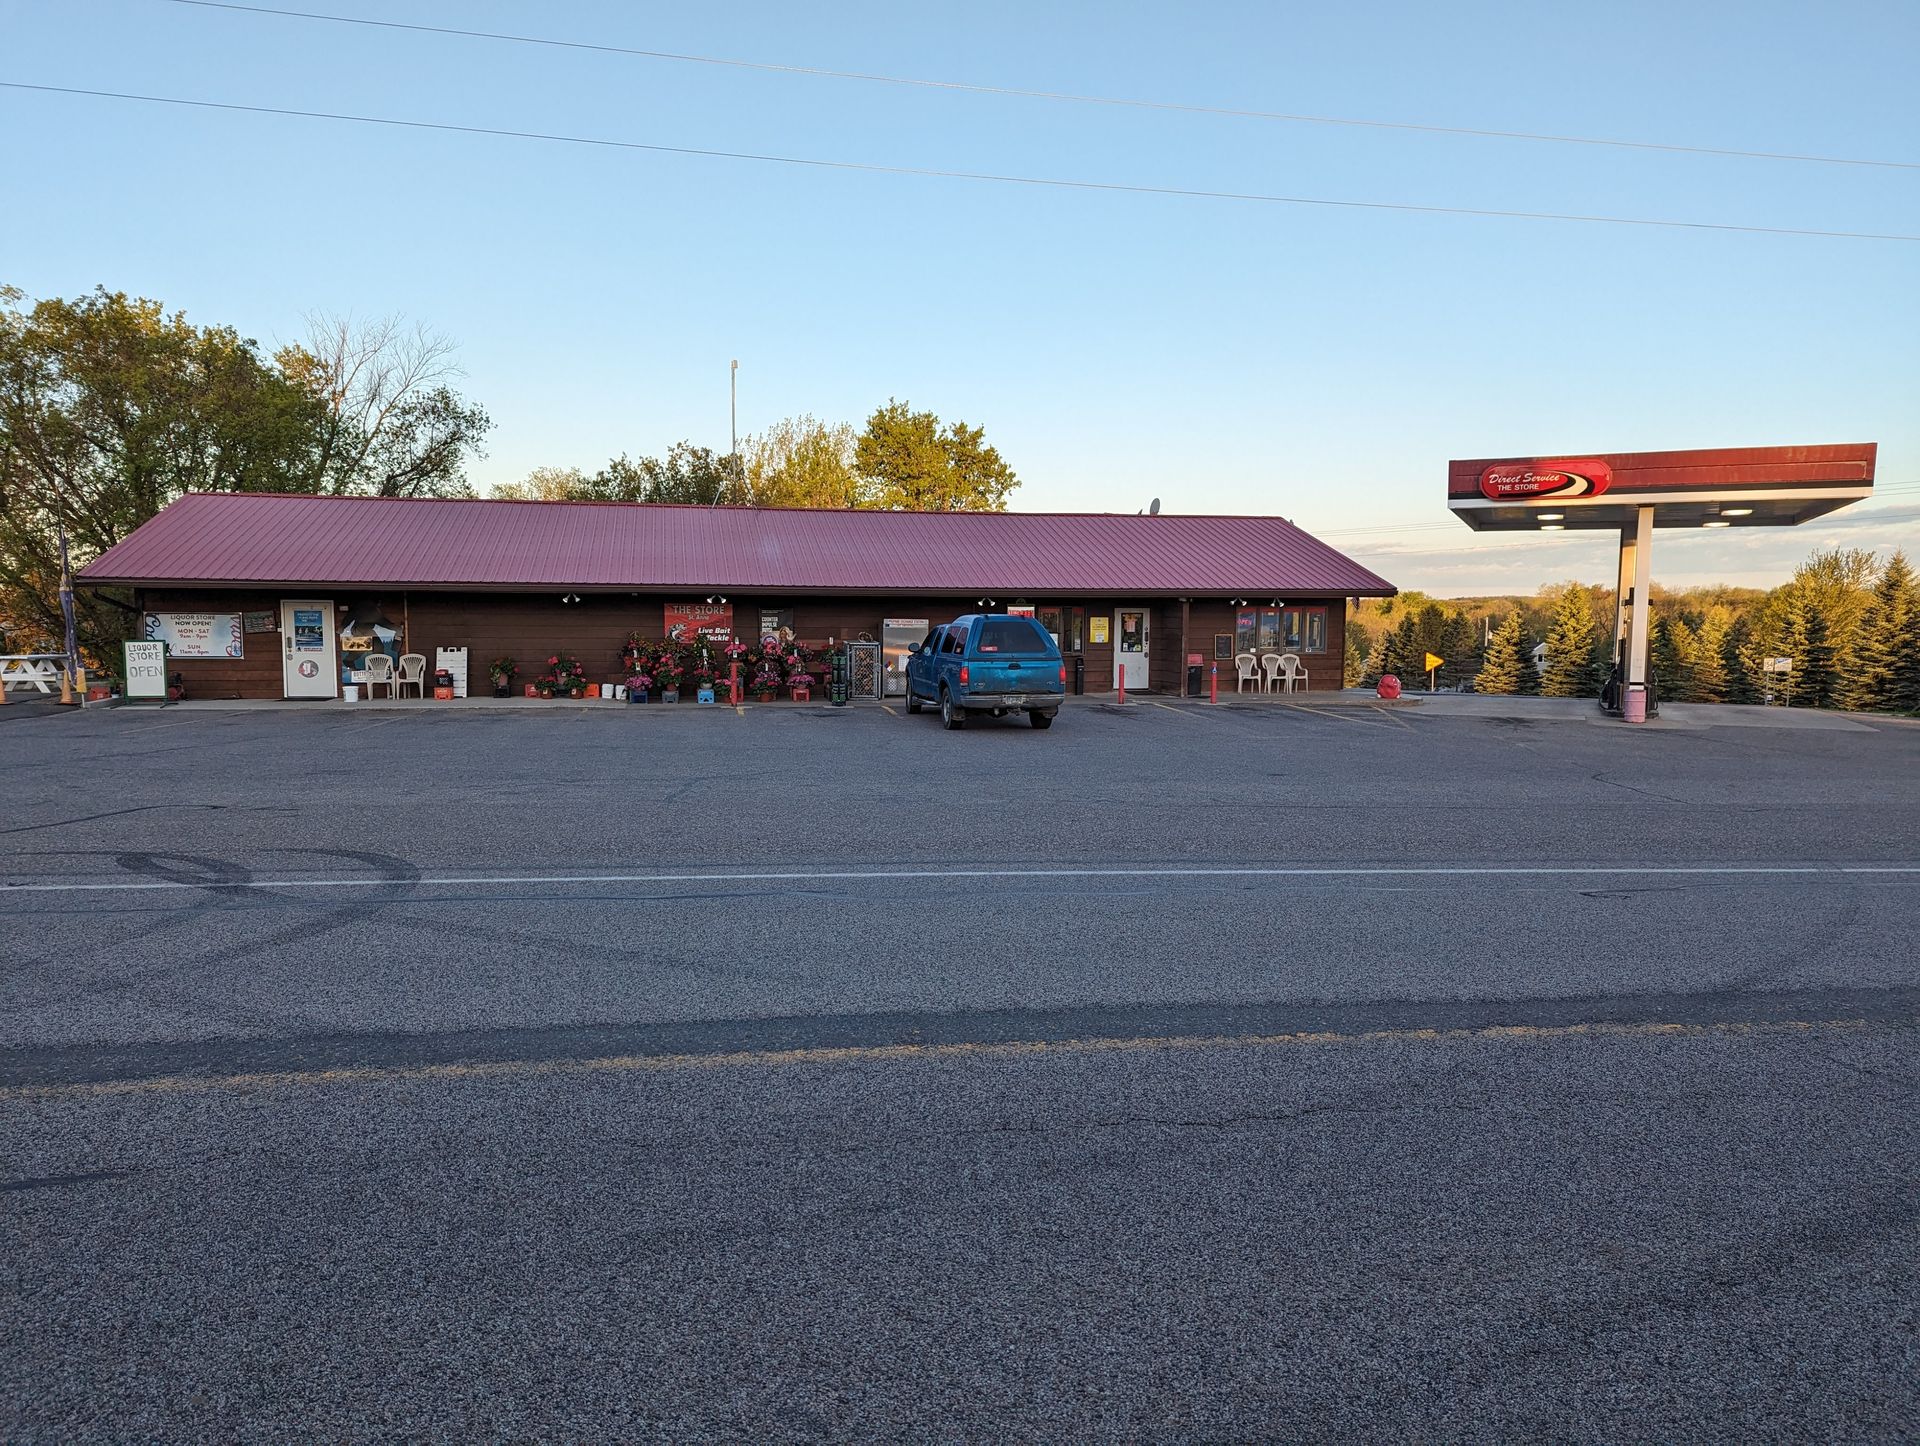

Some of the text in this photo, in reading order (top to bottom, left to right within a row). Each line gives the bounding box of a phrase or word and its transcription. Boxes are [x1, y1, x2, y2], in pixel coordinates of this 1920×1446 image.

[1488, 472, 1560, 484] Direct Service
[1514, 483, 1539, 491] STORE
[673, 606, 725, 615] THE STORE
[706, 634, 730, 642] Tackle
[127, 644, 158, 652] LIQUOR
[129, 652, 161, 662] STORE
[129, 666, 163, 678] OPEN
